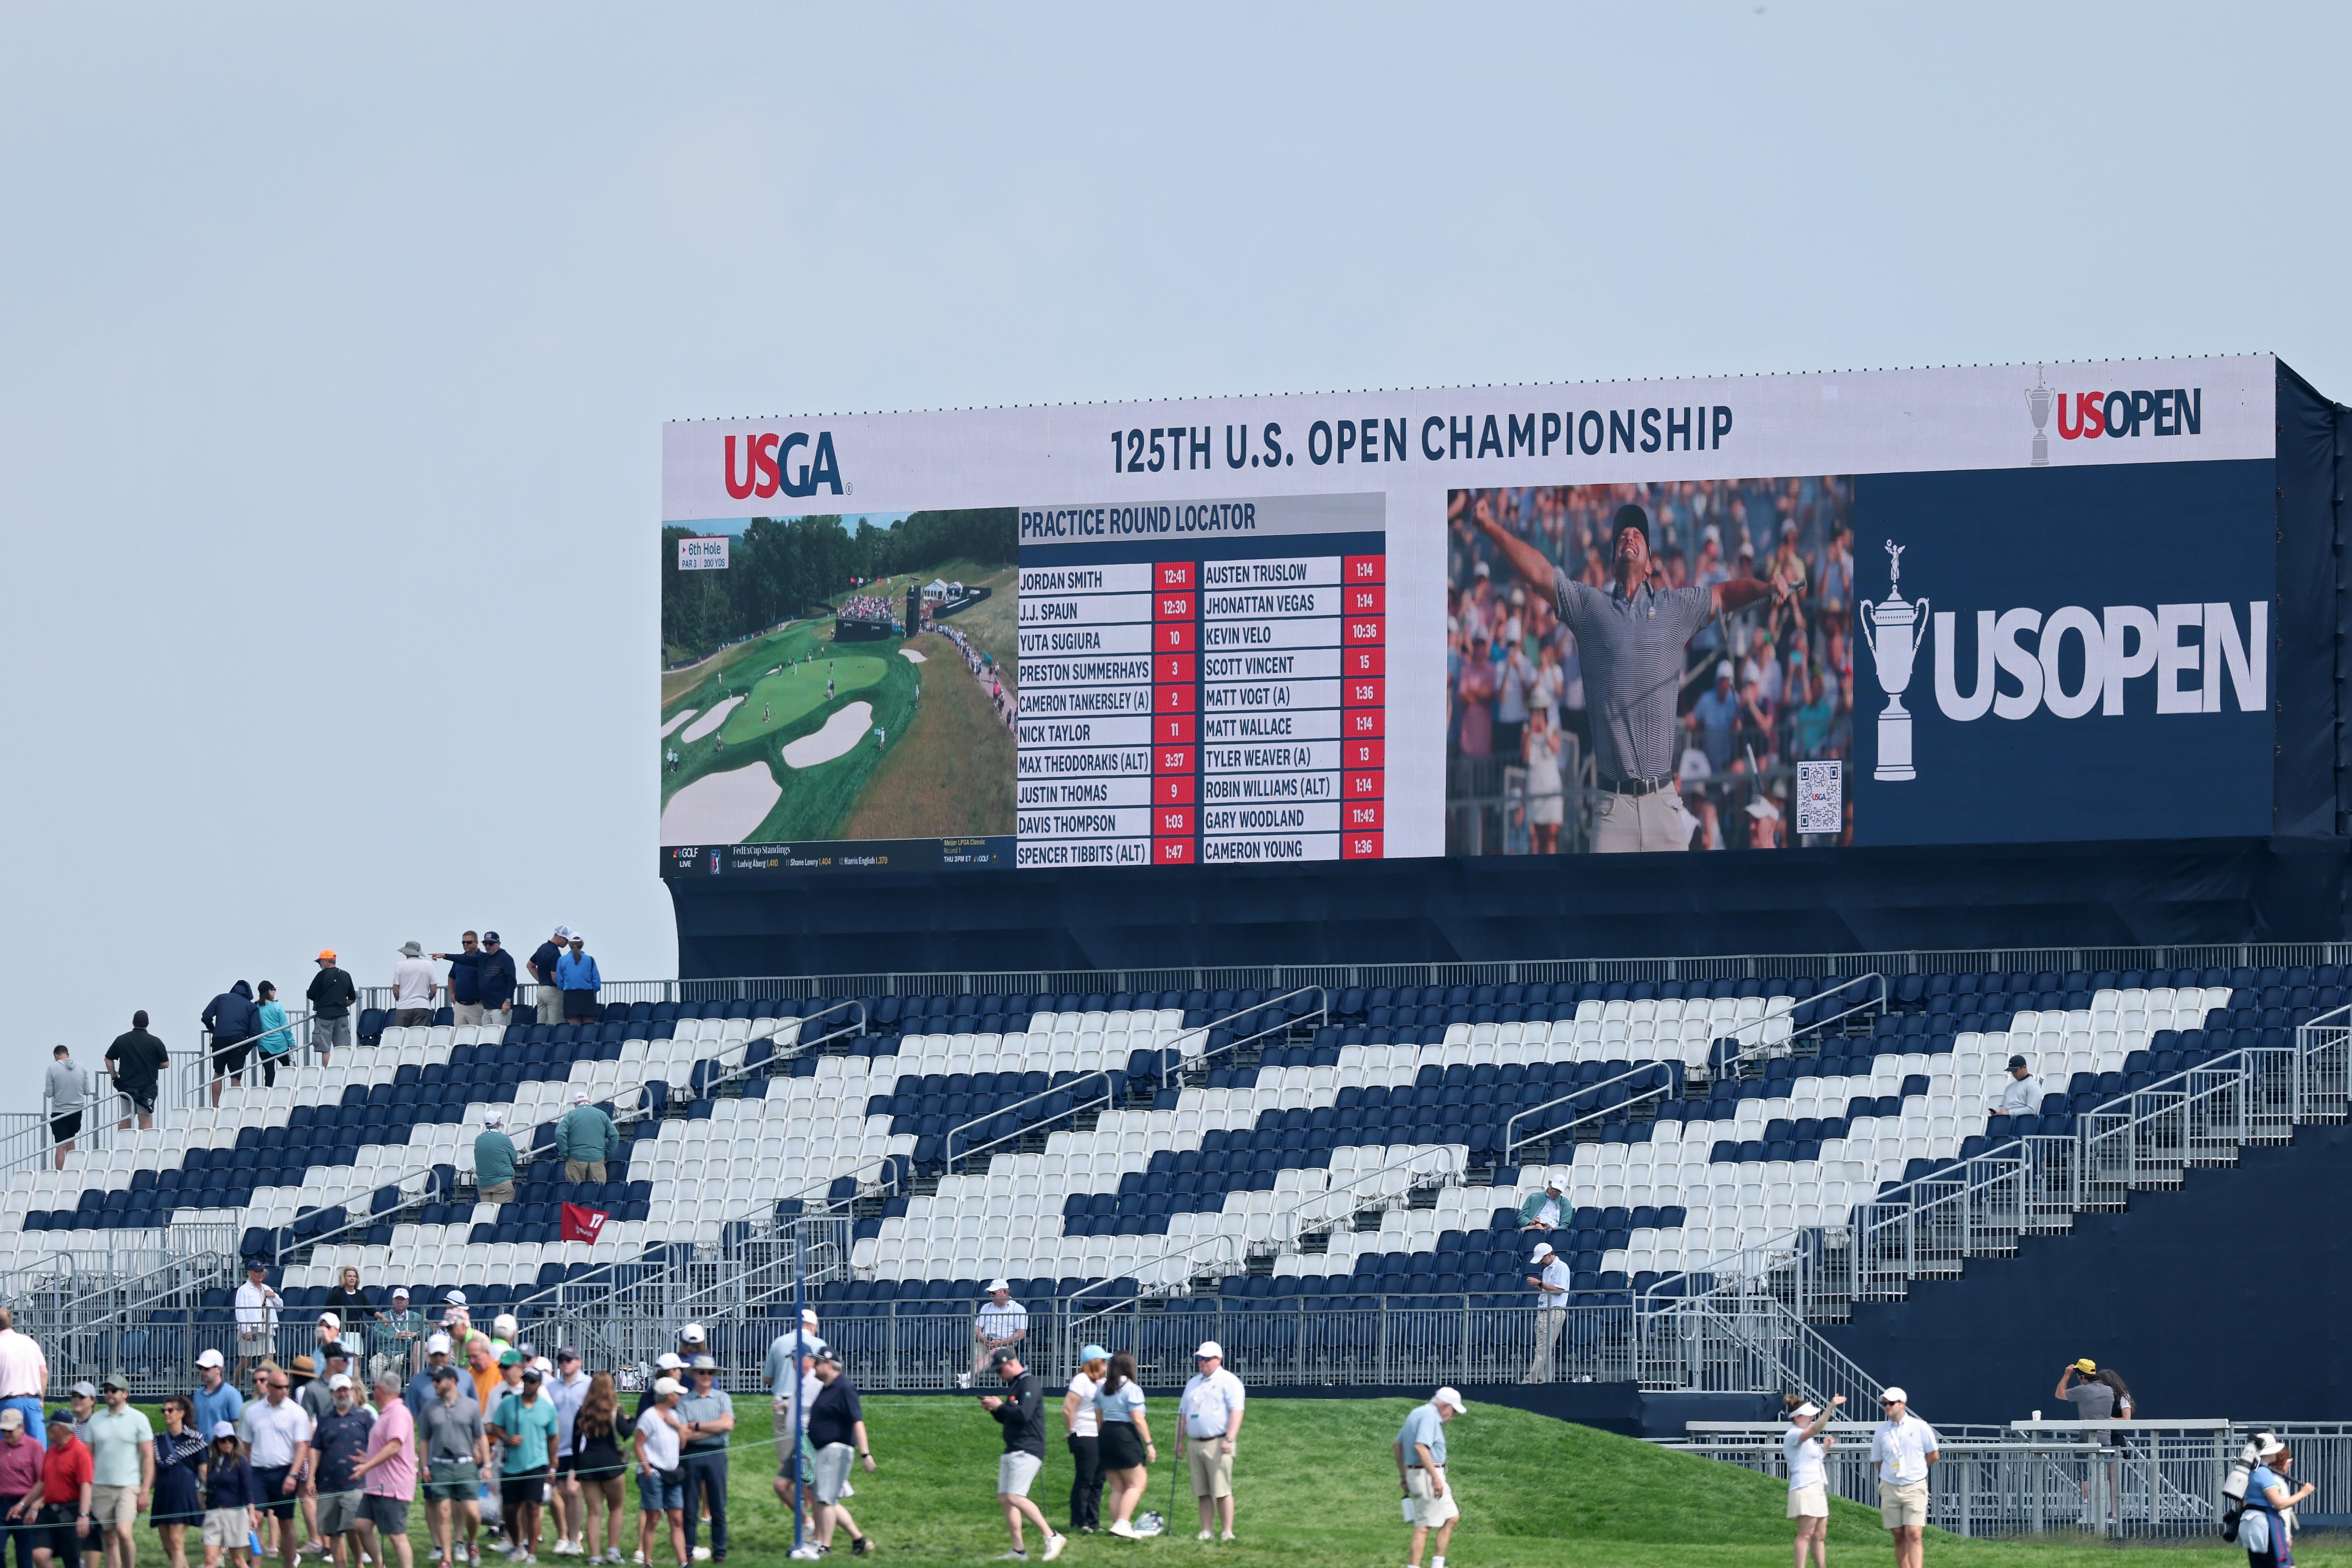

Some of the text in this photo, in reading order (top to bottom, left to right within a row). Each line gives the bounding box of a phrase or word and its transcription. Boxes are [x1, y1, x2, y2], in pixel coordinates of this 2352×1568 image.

[1112, 406, 1732, 473] 125TH U.S. OPEN CHAMPIONSHIP
[725, 431, 844, 499] USGA
[1022, 503, 1255, 538] PRACTICE ROUND LOCATOR
[689, 542, 721, 555] 6th Hole
[682, 560, 692, 568] PAR
[704, 559, 714, 567] 200
[715, 558, 725, 567] YDS
[1206, 563, 1373, 583] AUSTEN TRUSLOW 1:14
[1020, 570, 1185, 590] JORDAN SMITH 12:41
[1020, 600, 1186, 621] J.J. SPAUN 12:30
[1206, 594, 1373, 614] JHONATTAN VEGAS 1:14
[1020, 631, 1180, 651] YUTA SUGIURA 10
[1207, 624, 1376, 645] KEVIN VELO 10:36
[1020, 662, 1177, 681] PRESTON SUMMERHAYS 3
[1206, 655, 1369, 675] SCOTT VINCENT 15
[1020, 691, 1177, 712] CAMERON TANKERSLEY (A) 2
[1207, 686, 1373, 706] MATT VOGT (A) 1:36
[1020, 723, 1178, 743] NICK TAYLOR 11
[1207, 717, 1373, 736] MATT WALLACE 1:14
[1019, 752, 1184, 773] MAX THEODORAKIS (ALT) 3:37
[1206, 747, 1369, 767] TYLER WEAVER (A) 13
[1019, 784, 1177, 803] JUSTIN THOMAS 9
[1206, 777, 1372, 798] ROBIN WILLIAMS (ALT) 1:14
[1019, 815, 1183, 833] DAVIS THOMPSON 1:03
[1206, 809, 1374, 829] GARY WOODLAND 11:42
[682, 847, 699, 858] GOLF
[733, 845, 790, 856] FedExCup Standings
[1018, 844, 1182, 864] SPENCER TIBBITS (ALT) 1:47
[1206, 839, 1372, 859] CAMERON YOUNG 1:36
[738, 859, 752, 869] Ludvig
[790, 858, 804, 866] Shane
[805, 858, 818, 867] Lowry
[858, 856, 875, 866] English
[589, 1213, 604, 1228] 17
